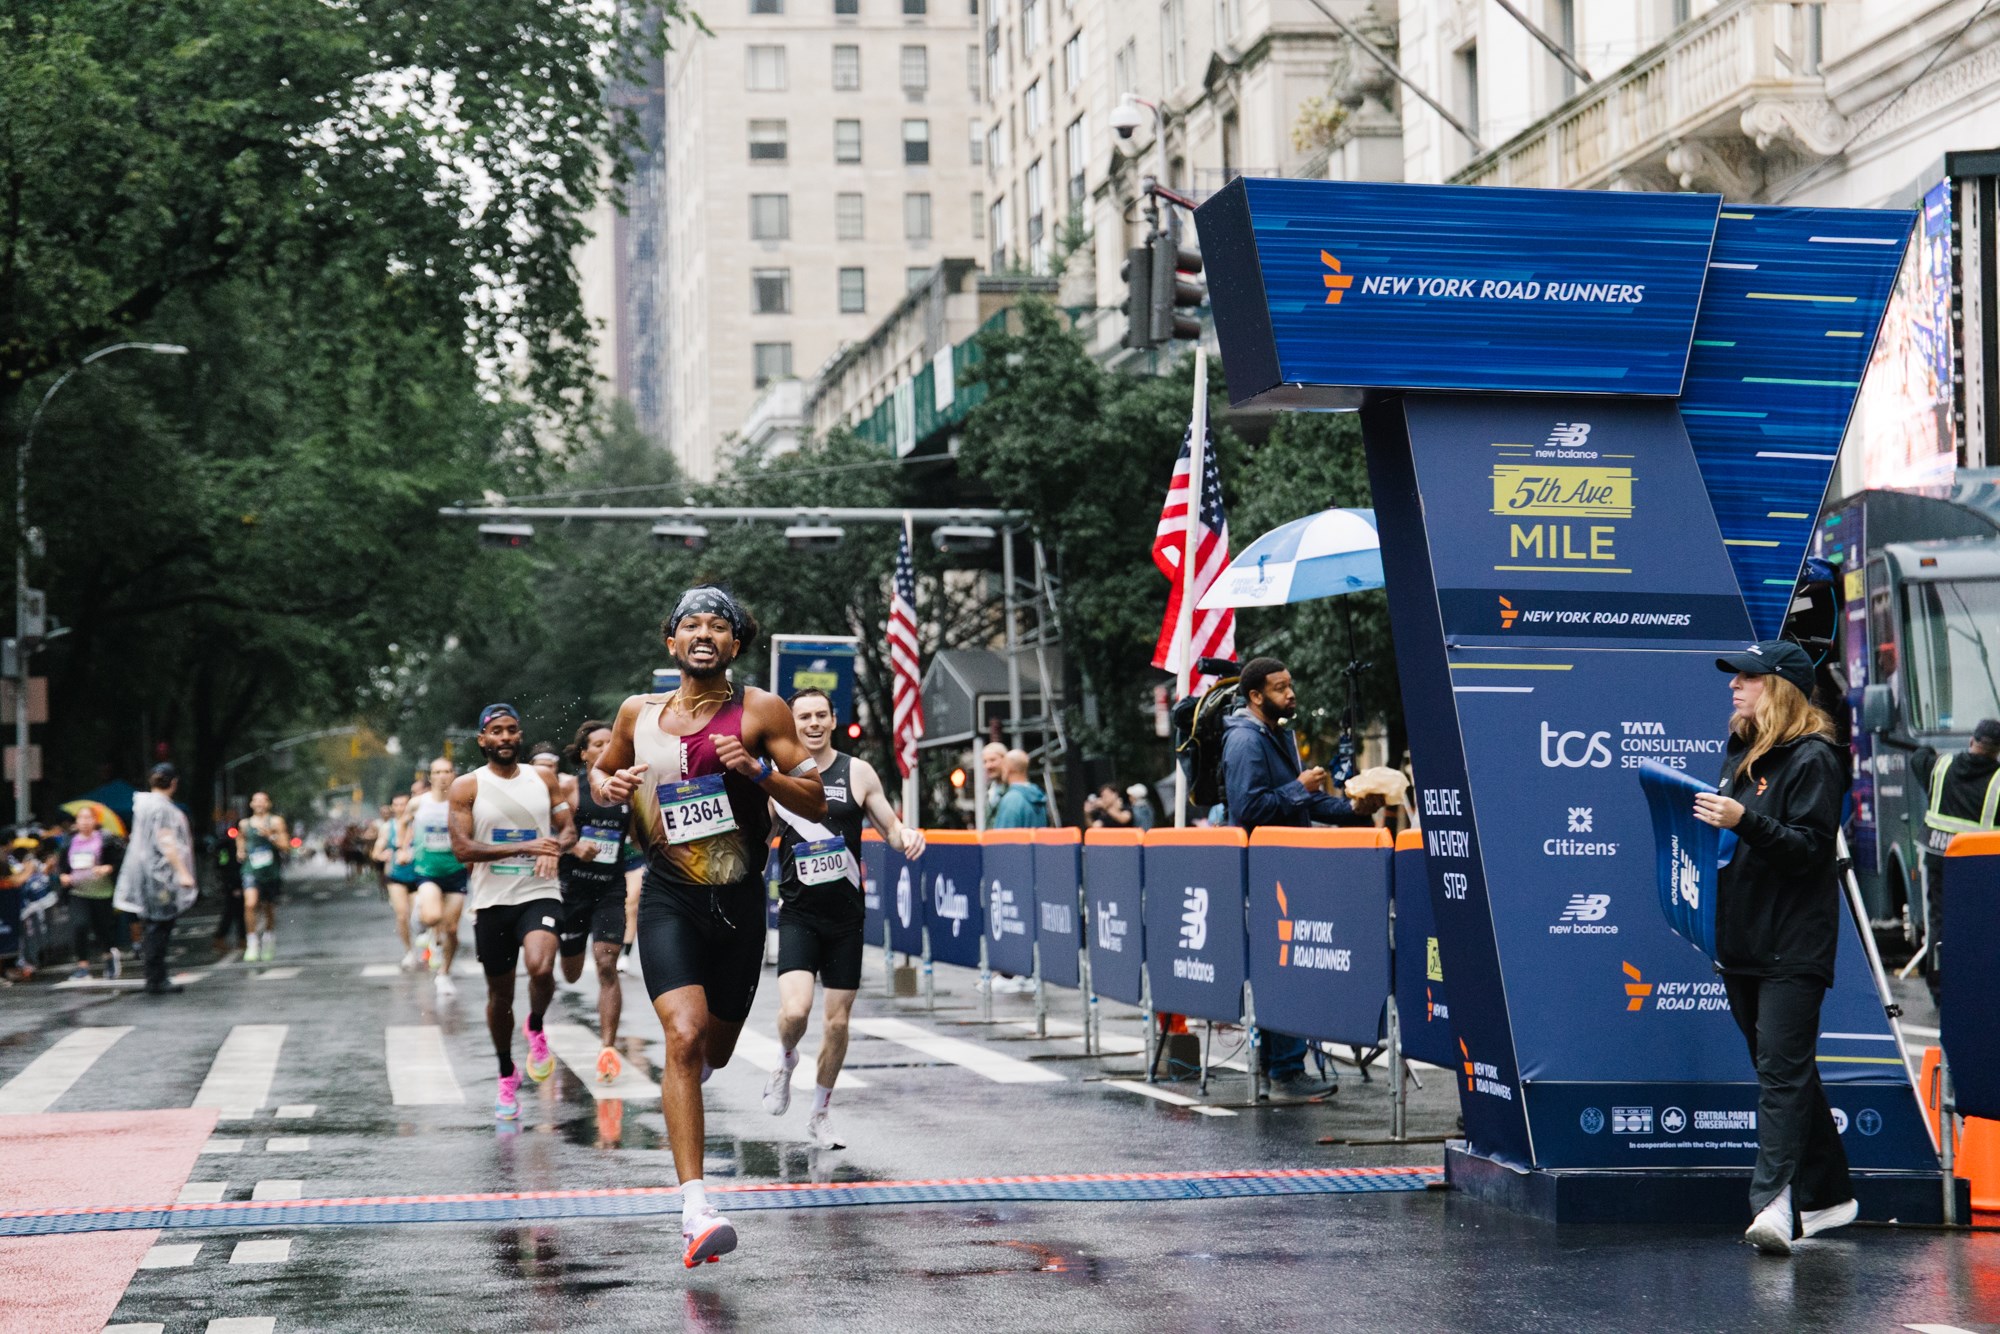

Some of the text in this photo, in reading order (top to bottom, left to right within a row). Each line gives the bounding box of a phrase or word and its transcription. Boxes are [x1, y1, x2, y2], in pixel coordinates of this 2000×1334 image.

[1361, 275, 1645, 304] NEW YORK ROAD RUNNERS
[1535, 449, 1598, 459] new balance
[1508, 476, 1614, 509] 5th Ave.
[1510, 523, 1616, 560] MILE
[1522, 610, 1692, 626] NEW YORK ROAD RUNNERS
[1620, 721, 1666, 735] TATA
[1540, 720, 1612, 769] tcs
[1620, 738, 1725, 753] CONSULTANCY
[680, 742, 689, 775] BANDIT
[1423, 788, 1462, 816] BELIEVE
[664, 798, 723, 830] E 2364
[1428, 830, 1469, 858] IN EVERY
[1543, 838, 1617, 856] Citizens
[799, 854, 843, 875] E 2500
[1671, 834, 1680, 906] new balance
[1443, 872, 1468, 900] STEP
[1293, 919, 1334, 943] NEW YORK
[1549, 924, 1619, 934] new balance
[1293, 945, 1352, 972] ROAD RUNNERS
[1656, 982, 1691, 995] NEW
[1655, 997, 1731, 1011] ROAD RUN
[1474, 1061, 1499, 1080] NEW YORK
[1476, 1078, 1512, 1100] ROAD RUNNERS
[1694, 1111, 1749, 1120] CENTRAL PARK
[1694, 1120, 1749, 1129] CONSERVANCY
[1636, 1141, 1677, 1150] cooperation
[1677, 1141, 1692, 1149] with
[1704, 1141, 1719, 1149] City
